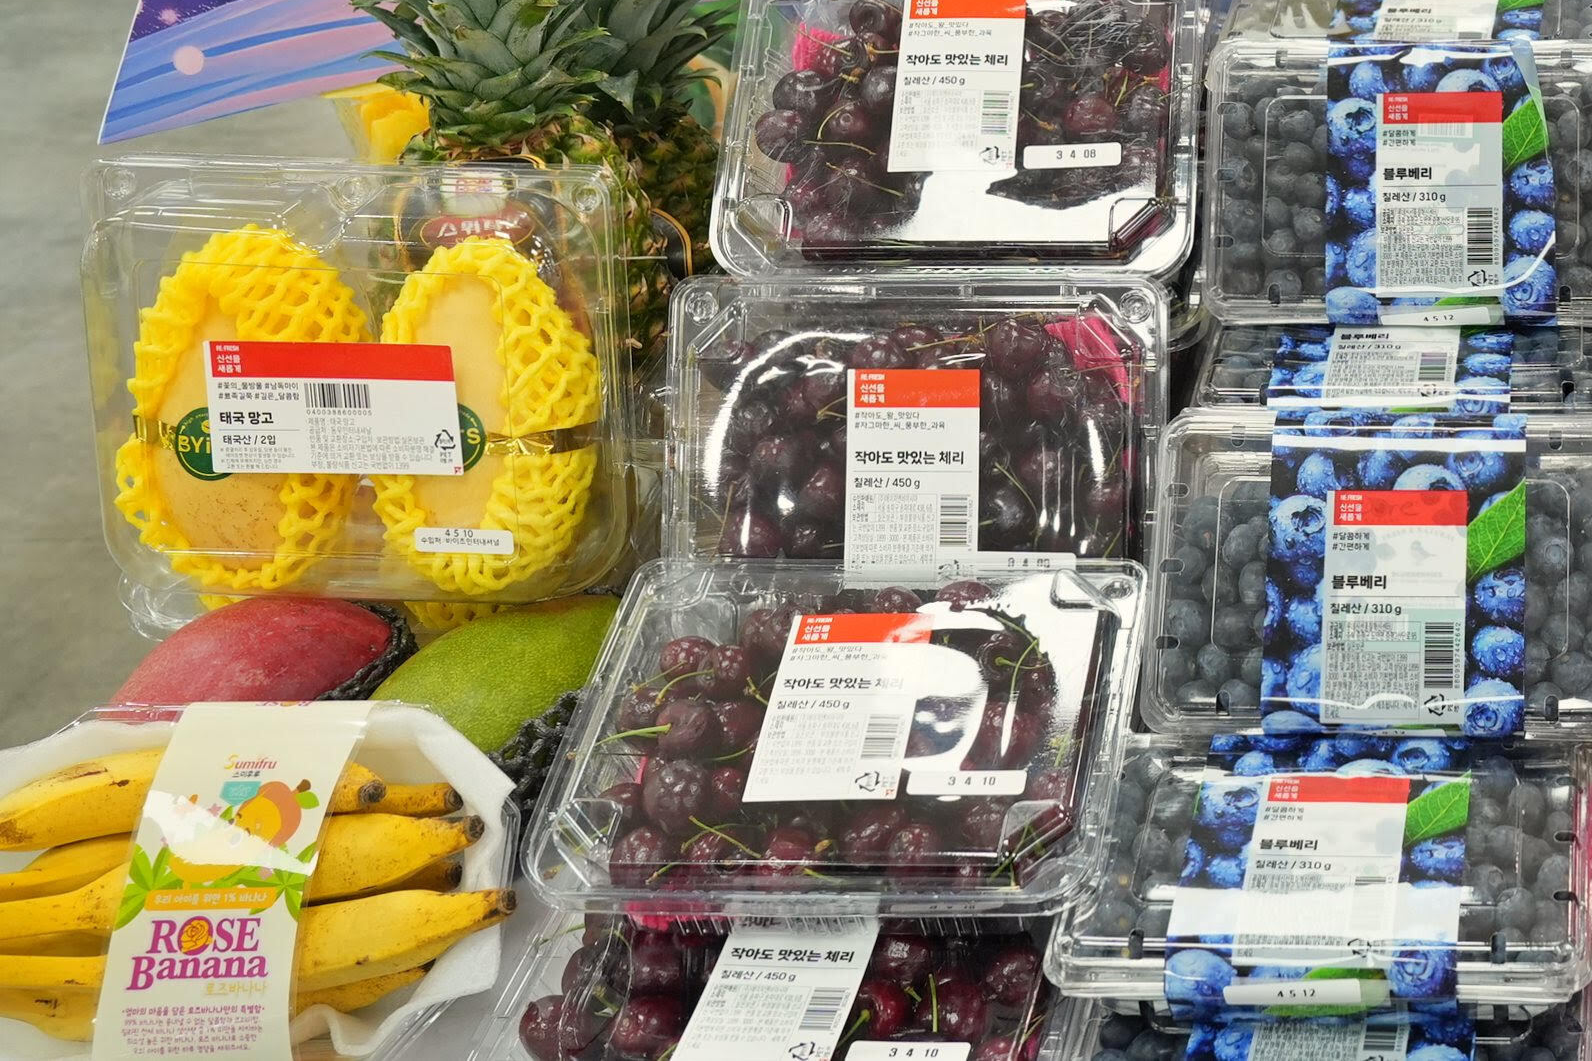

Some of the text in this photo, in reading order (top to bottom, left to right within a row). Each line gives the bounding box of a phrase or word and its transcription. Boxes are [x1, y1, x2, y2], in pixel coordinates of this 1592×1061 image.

[906, 53, 1008, 66] 작아도 맛있는 체리
[904, 76, 965, 86] 칠레산 450 g
[1056, 149, 1096, 159] 3 4 08
[1383, 167, 1432, 180] 블루베리
[1419, 192, 1438, 202] 310
[1440, 194, 1446, 203] g
[216, 355, 241, 363] 신선을
[217, 365, 242, 373] 새롭게
[860, 384, 885, 393] 신선을
[860, 394, 885, 403] 새롭게
[220, 412, 274, 424] 태국 망고
[223, 435, 251, 445] 태국산
[260, 435, 276, 445] 2입
[854, 451, 964, 465] 작아도 맛있는 체리
[854, 478, 921, 490] 칠레산 450 g
[1340, 504, 1362, 512] 신선을
[1340, 513, 1362, 521] 새롭게
[454, 529, 459, 537] 5
[463, 530, 474, 538] 10
[1332, 532, 1370, 540] #달콤하게
[1332, 543, 1370, 551] #간편하게
[1331, 575, 1387, 589] 블루베리
[1330, 603, 1402, 616] 칠레산 310 g
[804, 625, 831, 633] 신선을
[801, 633, 829, 641] 새롭게
[783, 678, 825, 690] 작아도
[829, 678, 872, 690] 맛있는
[777, 700, 850, 710] 칠레산 450 g
[224, 753, 277, 770] Sumifru
[948, 776, 996, 786] 3 4 10
[1260, 839, 1318, 850] 블루베리
[1255, 860, 1288, 869] 칠레산
[1299, 860, 1321, 869] 310
[155, 894, 171, 904] 우리
[203, 893, 220, 905] 위한
[224, 893, 236, 902] 1%
[239, 891, 267, 903] 바나나
[146, 915, 261, 956] ROSE
[731, 947, 856, 964] 작아도 맛있는 체리
[126, 955, 268, 990] Banana
[721, 970, 797, 982] 칠레산 450 g
[204, 982, 268, 997] 로즈바나나
[888, 1048, 939, 1058] 3 4 10
